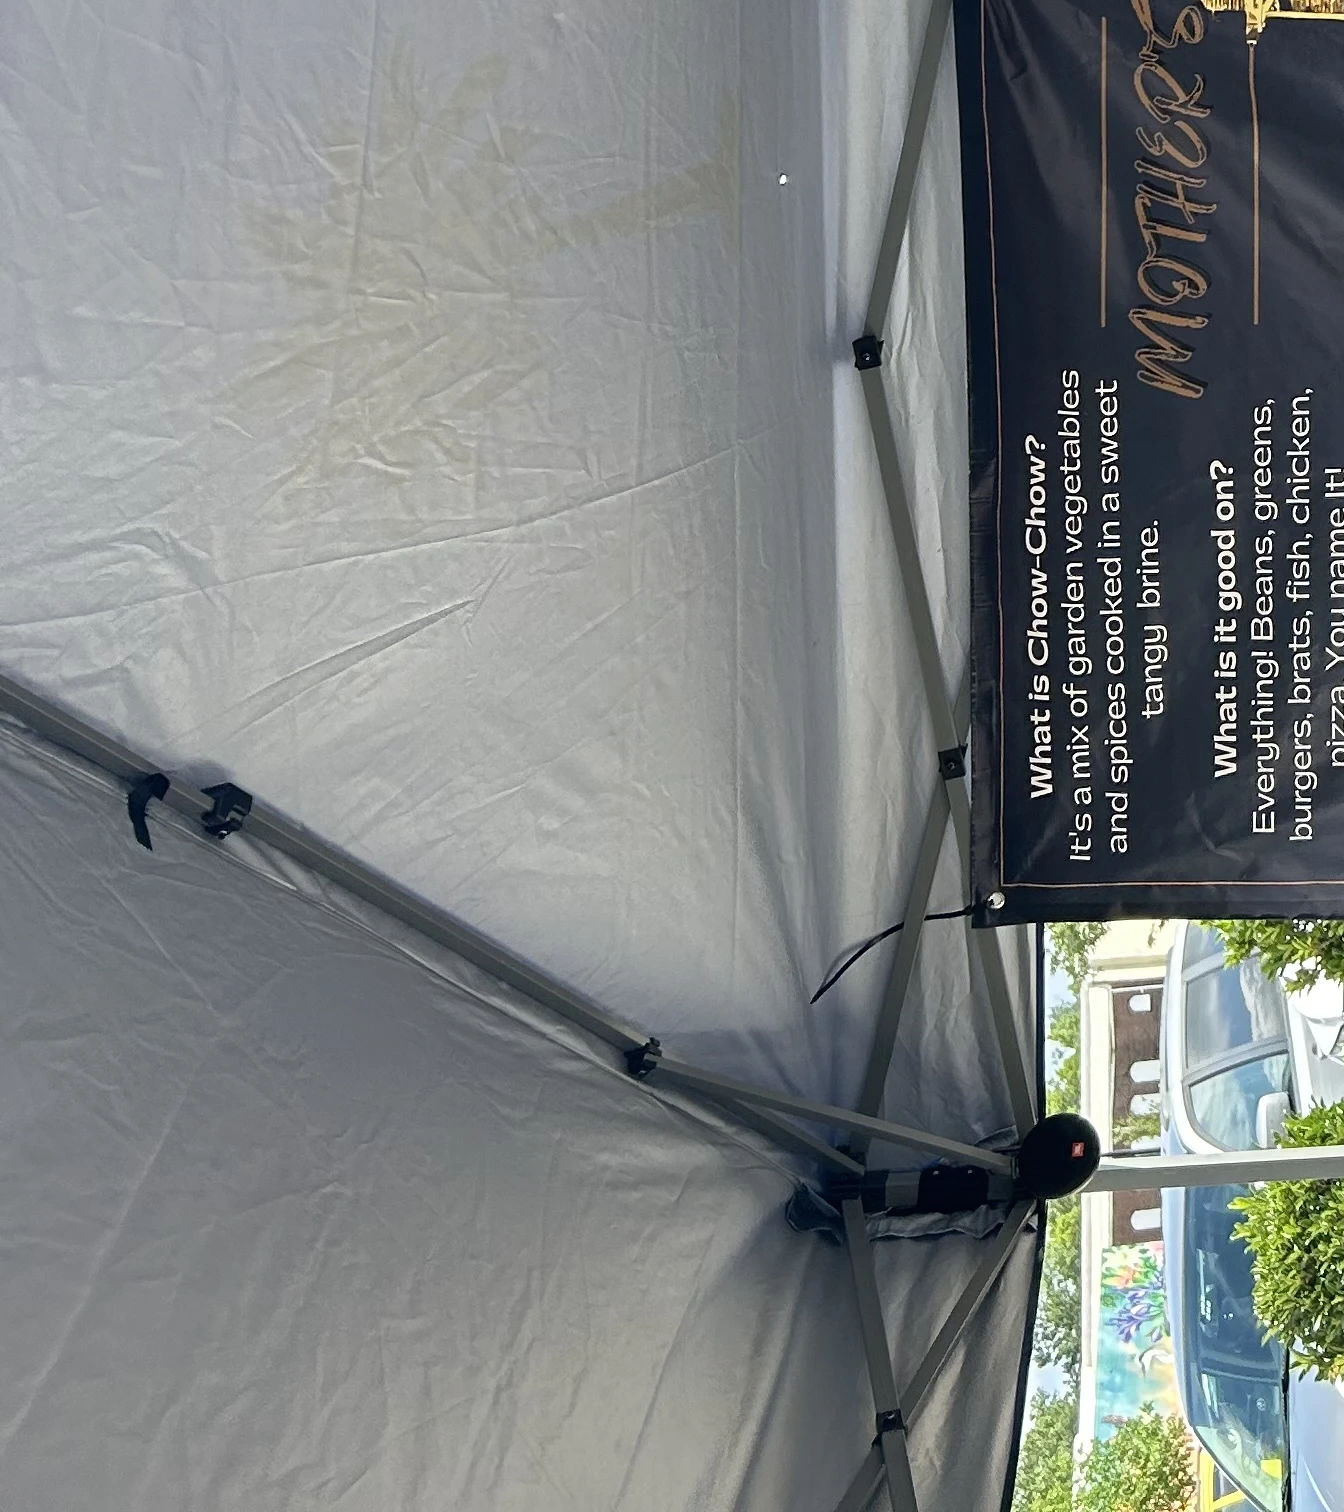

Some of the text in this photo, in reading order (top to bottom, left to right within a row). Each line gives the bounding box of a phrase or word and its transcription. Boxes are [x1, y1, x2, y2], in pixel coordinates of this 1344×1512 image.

[1025, 435, 1052, 798] What is Chow-Chow?
[1058, 370, 1092, 860] It's a mix of garden vegetables
[1095, 380, 1133, 852] and spices cooked in a sweet
[1136, 521, 1168, 719] tangy brine.
[1210, 461, 1242, 777] What is it good on?
[1250, 400, 1280, 832] Everything! Beans, greens,
[1286, 389, 1317, 840] burgers, brats, fish, chicken,
